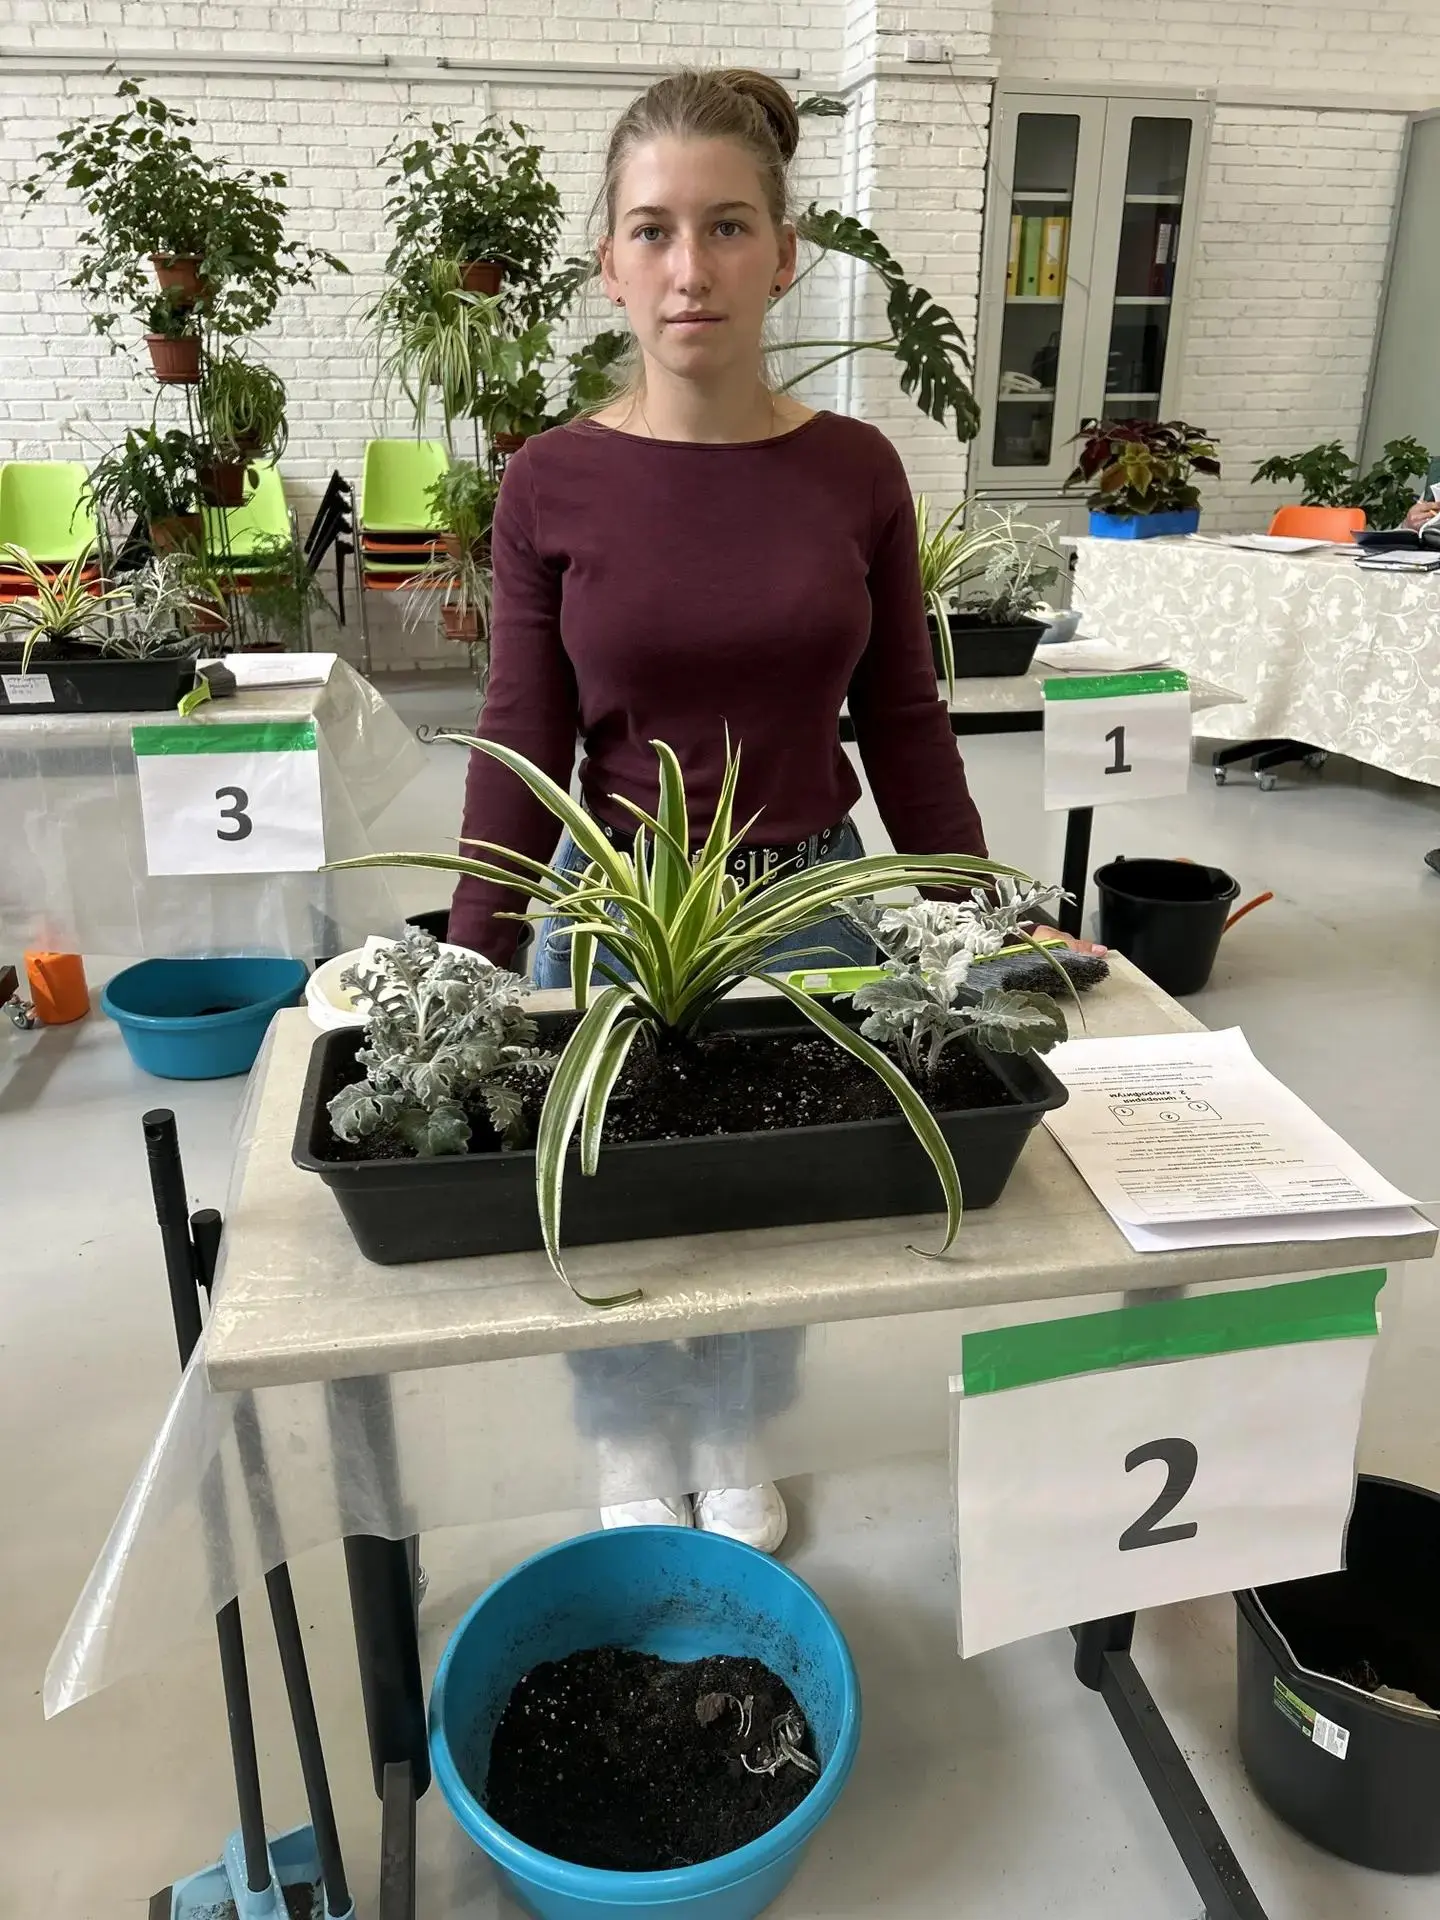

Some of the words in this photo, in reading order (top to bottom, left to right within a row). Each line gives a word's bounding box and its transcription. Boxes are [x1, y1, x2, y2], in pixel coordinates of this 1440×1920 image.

[1104, 726, 1132, 775] 1
[215, 786, 253, 841] 3
[1118, 1437, 1199, 1552] 2
